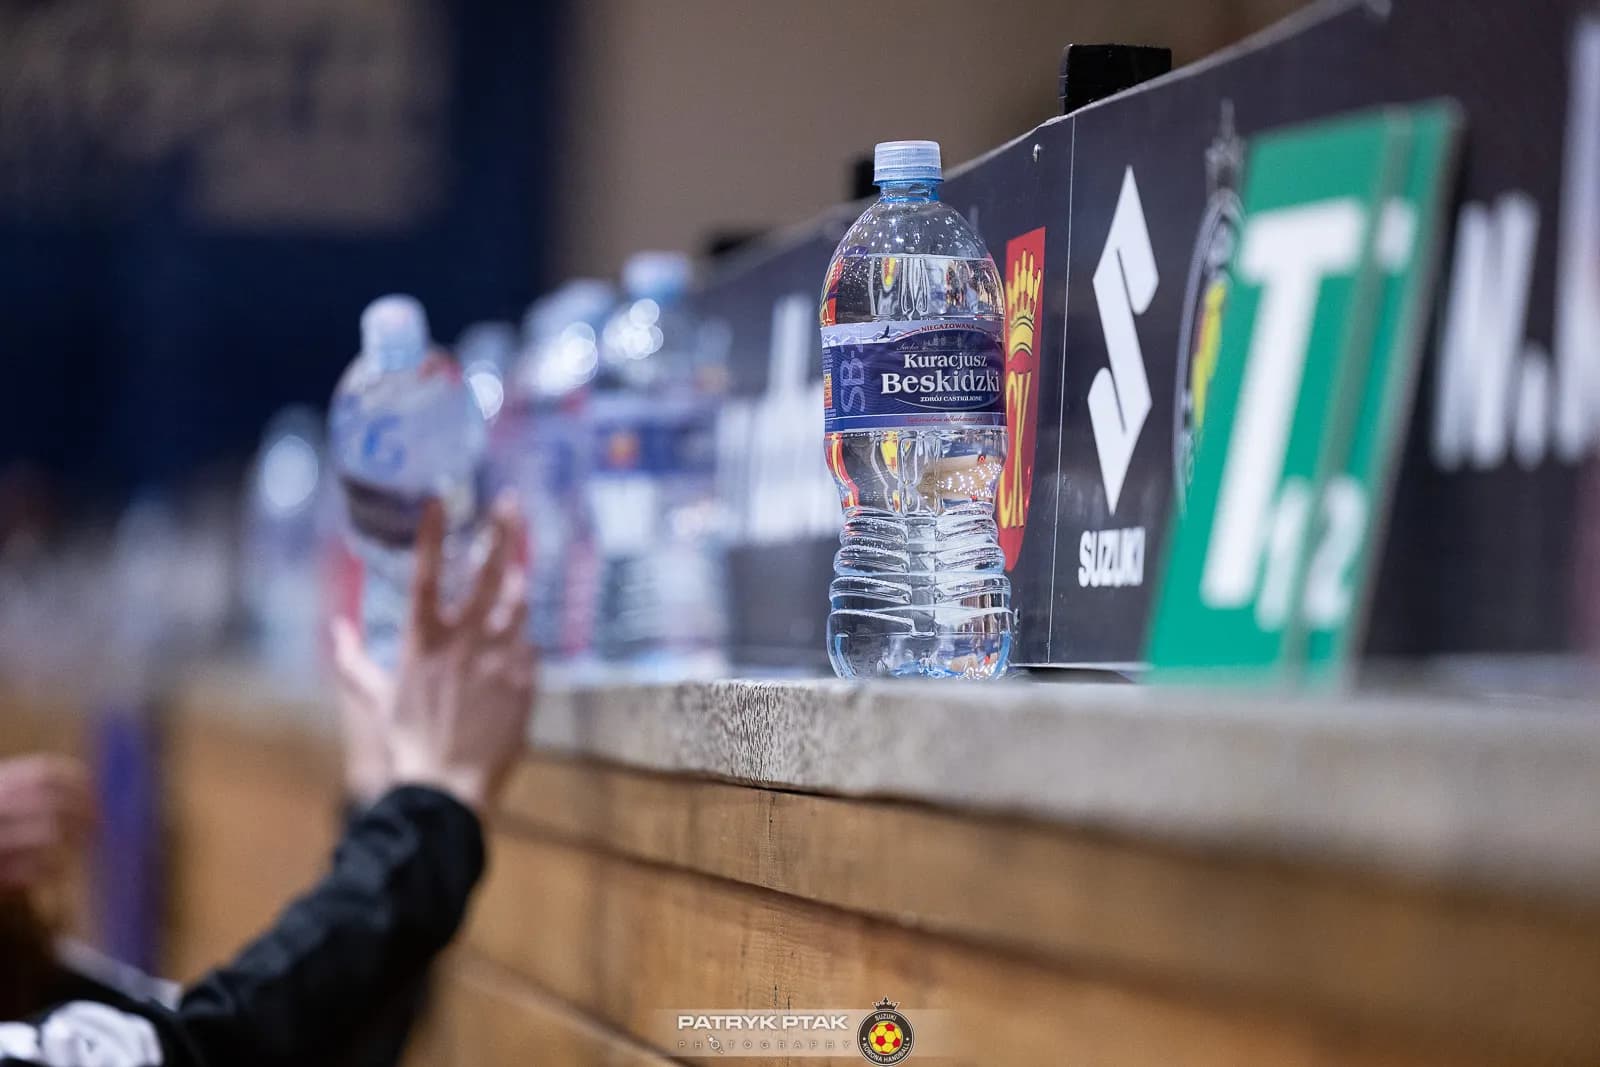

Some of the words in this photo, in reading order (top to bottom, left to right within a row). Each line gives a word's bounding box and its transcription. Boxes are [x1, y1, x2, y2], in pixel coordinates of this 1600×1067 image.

[903, 352, 988, 369] Kuracjusz
[880, 370, 1000, 394] Beskidzki
[1078, 526, 1145, 588] SUZUKI
